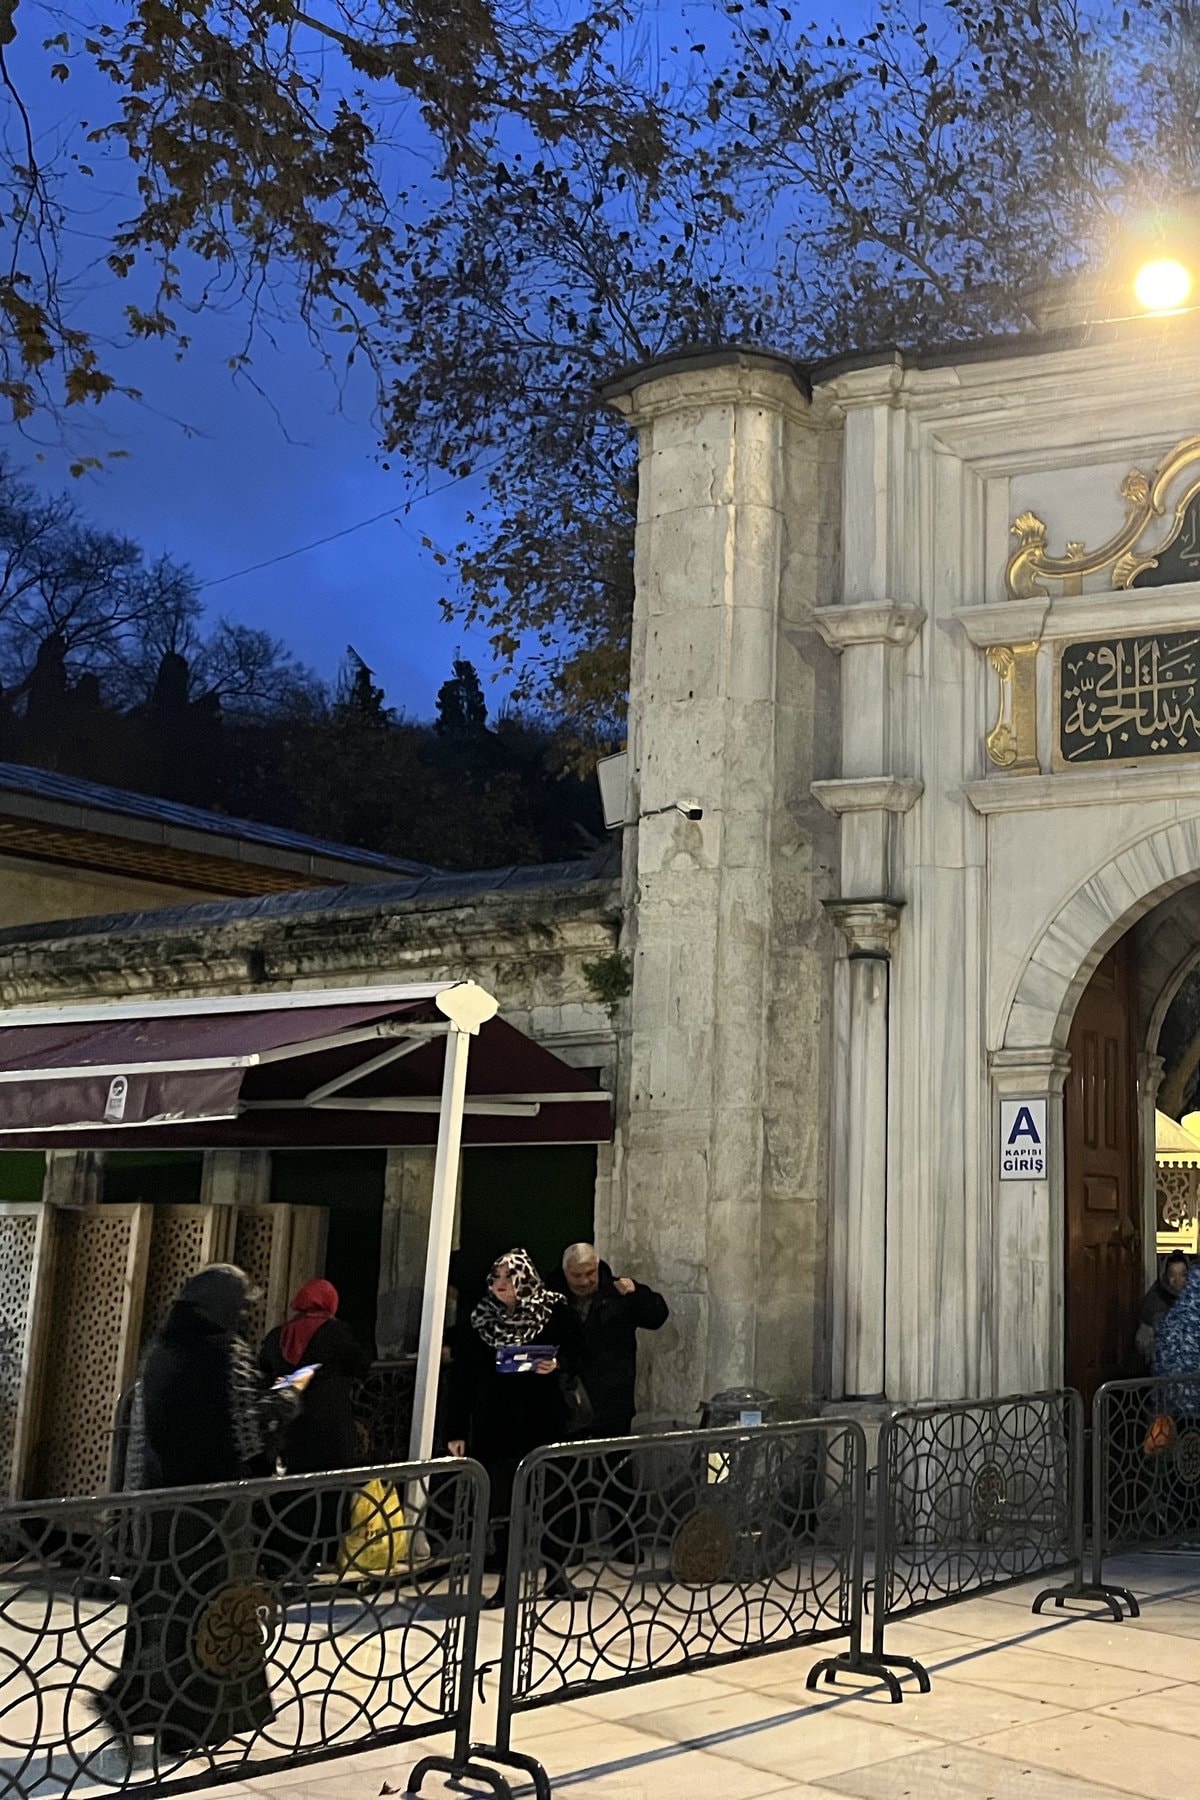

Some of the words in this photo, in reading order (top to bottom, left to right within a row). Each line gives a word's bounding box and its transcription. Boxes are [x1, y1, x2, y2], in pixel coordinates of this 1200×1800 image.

[1007, 1106, 1041, 1145] A
[1005, 1148, 1042, 1157] KAPISI
[1003, 1156, 1044, 1173] GİRİŞ
